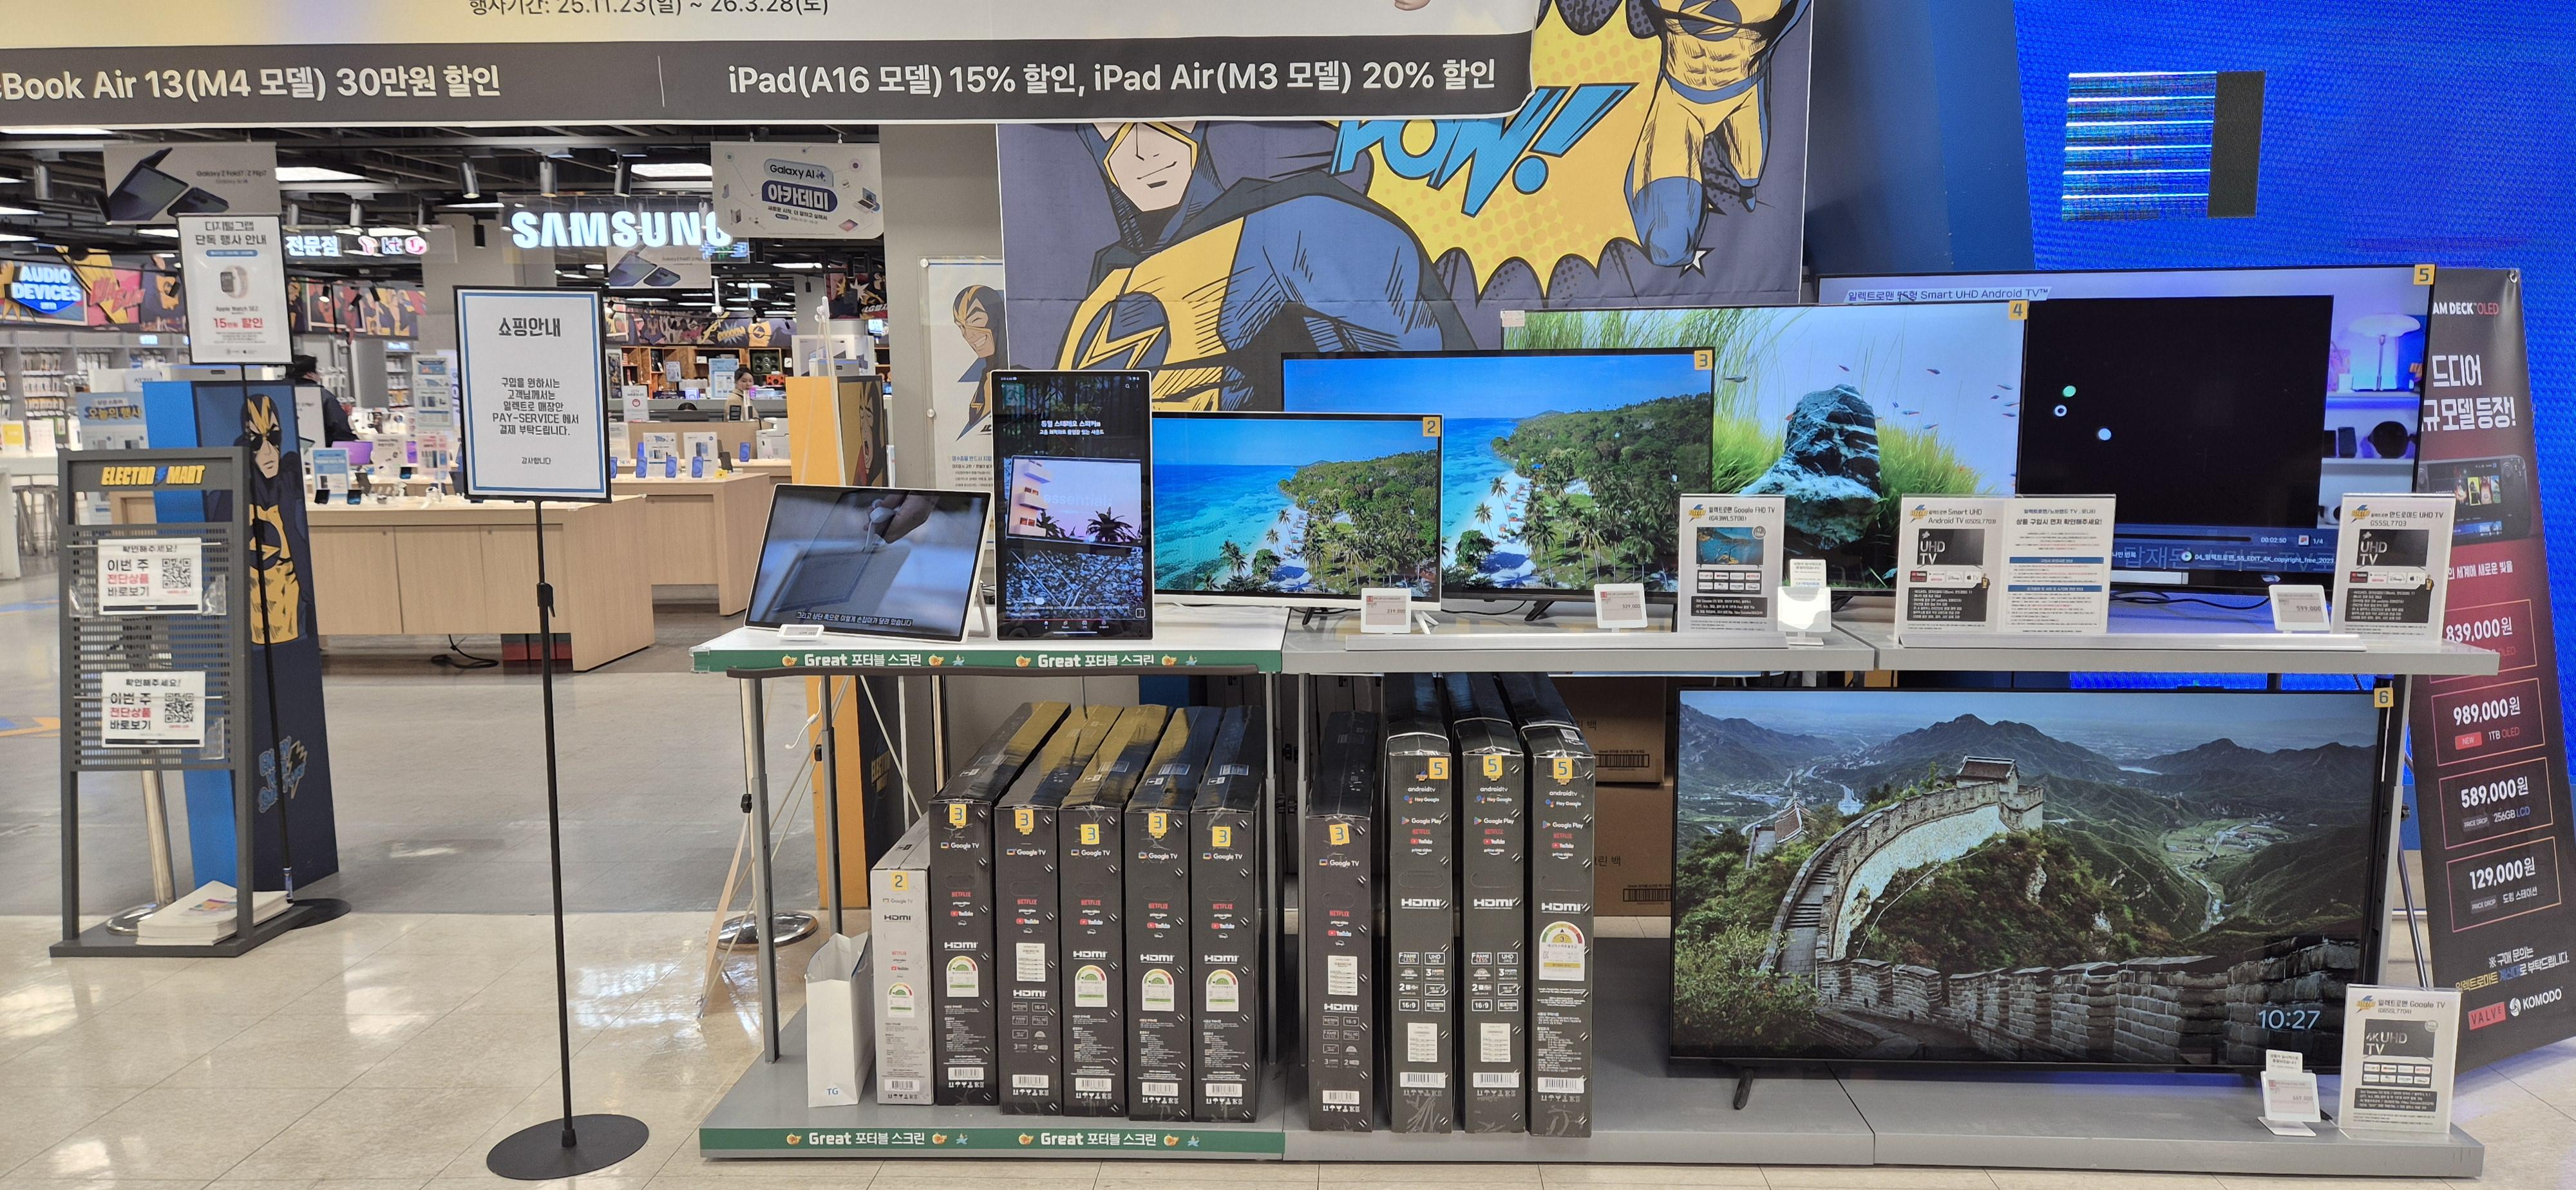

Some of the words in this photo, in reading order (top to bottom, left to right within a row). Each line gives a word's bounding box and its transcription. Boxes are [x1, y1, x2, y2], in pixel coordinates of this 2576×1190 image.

[0, 71, 85, 100] Book
[93, 70, 137, 99] Air
[144, 69, 251, 102] 13(M4
[260, 66, 326, 102] 모델)
[336, 65, 437, 97] 30만원
[443, 64, 500, 97] 할인
[728, 65, 870, 98] iPad(A16
[878, 64, 942, 97] 모델)
[950, 65, 1015, 93] 15%
[1023, 63, 1085, 97] 할인,
[1095, 63, 1160, 91] iPad
[1170, 62, 1278, 93] Air(M3
[1287, 60, 1352, 93] 모델)
[1363, 61, 1434, 89] 20%
[1443, 58, 1495, 89] 할인
[770, 164, 804, 180] Galaxy
[806, 169, 815, 179] AI
[768, 184, 829, 211] 아카데미
[205, 221, 254, 232] 디지털그랩
[195, 234, 217, 246] 단독
[220, 234, 242, 246] 행사
[245, 234, 267, 246] 안내
[285, 235, 343, 258] 전문점
[20, 265, 71, 284] AUDIO
[2420, 269, 2429, 281] 5
[12, 281, 82, 302] DEVICES
[1848, 290, 1895, 301] 일렉트로맨
[1920, 289, 1953, 299] Smart
[1955, 289, 1978, 299] UHD
[1981, 288, 2022, 299] Android
[2012, 303, 2023, 317] 4
[2477, 302, 2499, 315] OLED
[242, 318, 263, 329] 할인
[498, 317, 561, 337] 쇼핑안내
[1699, 353, 1708, 368] 3
[2432, 354, 2483, 387] 드디어
[501, 377, 524, 388] 구입을
[527, 378, 560, 388] 원하시는
[507, 390, 556, 401] 고객님께서는
[503, 401, 535, 411] 일렉트로
[538, 402, 564, 412] 매장안
[492, 413, 560, 424] PAY-SERVICE
[562, 414, 579, 425] 에서
[499, 425, 516, 435] 결제
[519, 425, 571, 437] 부탁드립니다.
[1427, 420, 1435, 434] 2
[521, 457, 552, 465] 감사합니다
[101, 466, 156, 486] ELECTRO
[166, 465, 205, 484] MART
[1920, 540, 1946, 552] UHD
[2360, 541, 2388, 553] UHD
[107, 559, 132, 572] 이번
[137, 559, 149, 572] 주
[1920, 553, 1937, 565] TV
[2360, 553, 2378, 565] TV
[2456, 563, 2476, 580] 세계에
[2477, 562, 2498, 578] 새로운
[107, 573, 149, 585] 전단상품
[108, 587, 149, 597] 바로보기
[796, 612, 812, 620] 그리고
[813, 612, 824, 621] 상단
[840, 614, 857, 623] 이렇게
[890, 618, 913, 627] 있습니다
[2446, 616, 2513, 643] 839,000원
[804, 653, 848, 666] Great
[851, 654, 885, 666] 포터블
[887, 654, 922, 666] 스크린
[1037, 654, 1081, 668] Great
[1084, 654, 1118, 667] 포터블
[1121, 654, 1155, 666] 스크린
[126, 679, 181, 687] 확인해주세요!
[110, 693, 135, 705] 이번
[140, 693, 151, 705] 주
[2379, 690, 2389, 704] 6
[110, 707, 151, 718] 전단상품
[2452, 695, 2521, 726] 989,000원
[109, 720, 151, 730] 바로보기
[2462, 737, 2474, 745] NEW
[2488, 730, 2501, 741] 1TB
[2502, 726, 2520, 739] OLED
[1434, 762, 1443, 775] 5
[1488, 759, 1497, 772] 5
[2461, 776, 2529, 809] 589,000원
[954, 807, 963, 821] 3
[1020, 812, 1029, 826] 3
[2464, 818, 2477, 828] PRICE
[2477, 817, 2488, 826] DROP
[2494, 809, 2516, 823] 256GB
[2516, 806, 2530, 818] LCD
[2469, 856, 2536, 891] 129,000원
[895, 874, 904, 888] 2
[2515, 886, 2538, 902] 스테이션
[2497, 951, 2512, 965] 구매
[2512, 945, 2534, 961] 문의는
[2455, 971, 2499, 992] 일렉트로마트
[2528, 951, 2570, 978] 부탁드립니다.
[2410, 1001, 2434, 1009] Google
[2523, 987, 2562, 1010] KOMODO
[2258, 1009, 2321, 1030] 10:27
[2471, 1006, 2503, 1028] VALVE
[2381, 1032, 2407, 1044] UHD
[2365, 1043, 2385, 1055] TV
[809, 1132, 852, 1146] Great
[855, 1133, 889, 1145] 포터블
[891, 1133, 925, 1146] 스크린
[1041, 1133, 1084, 1146] Great
[1087, 1133, 1121, 1146] 포터블
[1123, 1133, 1157, 1146] 스크린
